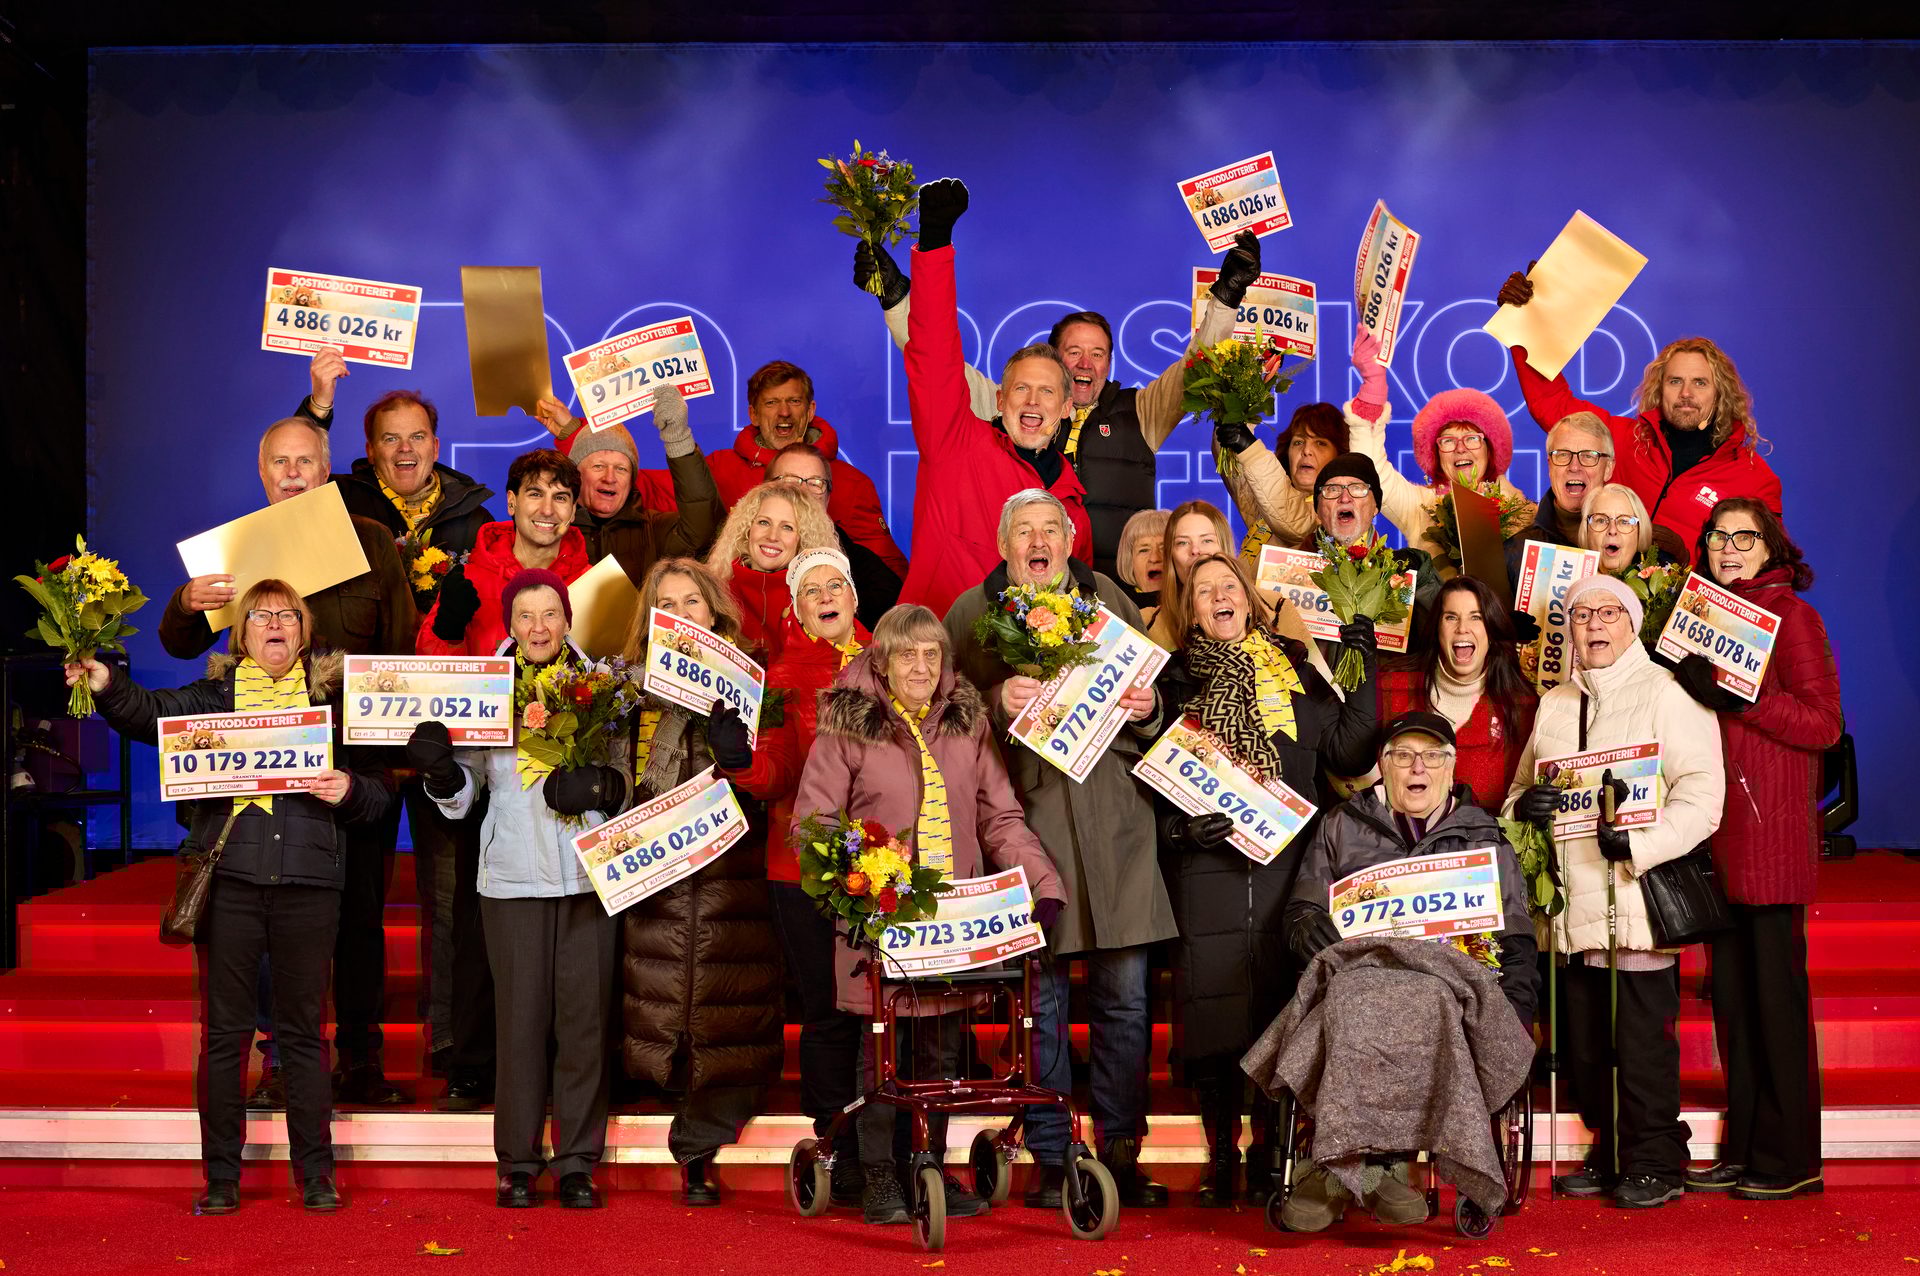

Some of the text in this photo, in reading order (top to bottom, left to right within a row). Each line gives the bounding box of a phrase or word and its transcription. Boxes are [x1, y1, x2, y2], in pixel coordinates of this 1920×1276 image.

[1194, 162, 1258, 191] POSTKODLOTTERIET
[1202, 213, 1212, 229] 4
[1211, 203, 1239, 226] 886
[1239, 194, 1263, 217] 026
[1264, 194, 1276, 208] kr
[291, 276, 396, 299] POSTKODLOTTERIET
[1365, 290, 1382, 329] 886
[1375, 251, 1393, 289] 026
[1385, 231, 1398, 250] kr
[277, 308, 402, 341] 4 886 026 kr
[1235, 306, 1308, 333] 86 026 kr
[589, 325, 679, 360] POSTKODLOTTERIET
[591, 384, 606, 403] 9
[608, 367, 650, 396] 772
[652, 357, 683, 379] 052
[684, 357, 698, 373] kr
[887, 300, 1657, 425] POSKOD
[1289, 588, 1329, 612] 886
[1697, 583, 1762, 624] POSTKODLOTTERIET
[1316, 616, 1343, 626] GRANNYRA
[1541, 560, 1573, 690] 4 886 026 kr
[674, 621, 752, 673] POSTKODLOTTERIET
[1672, 611, 1689, 634] 14
[1687, 621, 1714, 648] 658
[1715, 634, 1745, 664] 078
[1744, 651, 1761, 672] kr
[372, 661, 487, 673] POSTKODLOTTERIET
[660, 651, 672, 671] 4
[676, 657, 712, 688] 886
[716, 676, 741, 708] 026
[743, 697, 754, 718] kr
[359, 697, 499, 718] 9 772 052 kr
[1051, 738, 1069, 755] 9
[1060, 703, 1097, 741] 772
[1087, 663, 1124, 704] 052
[1115, 644, 1138, 667] kr
[187, 714, 304, 731] POSTKODLOTTERIET
[170, 749, 324, 774] 10 179 222 kr
[1555, 747, 1642, 769] POSTKODLOTTERIET
[598, 781, 702, 841] POSTKODLOTTERIET
[1165, 747, 1181, 765] 1
[1179, 760, 1220, 796] 628
[1218, 791, 1258, 825] 676
[1254, 819, 1277, 840] kr
[1558, 790, 1592, 814] 886
[1632, 783, 1648, 801] kr
[606, 807, 729, 883] 4 886 026 kr
[1351, 857, 1467, 887] POSTKODLOTTERIET
[1341, 891, 1485, 928] 9 772 052 kr
[886, 913, 1029, 949] 29 723 326 kr
